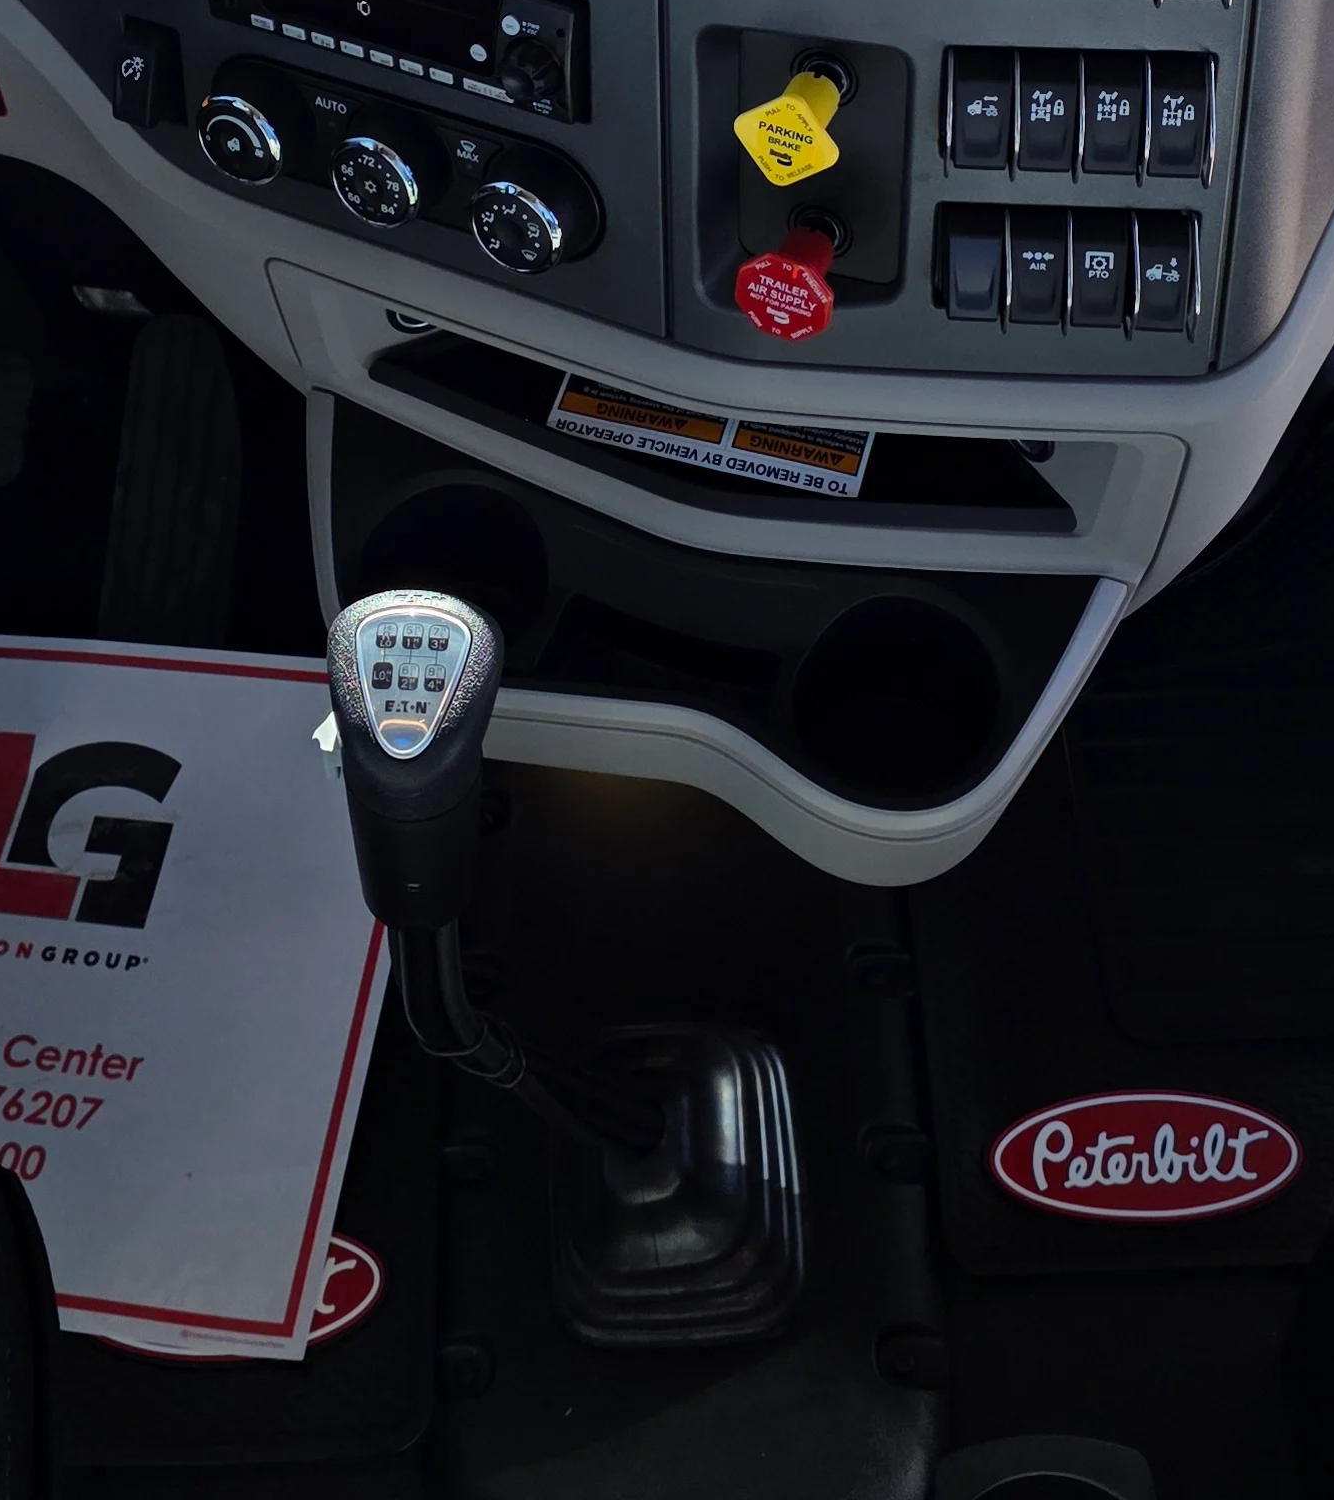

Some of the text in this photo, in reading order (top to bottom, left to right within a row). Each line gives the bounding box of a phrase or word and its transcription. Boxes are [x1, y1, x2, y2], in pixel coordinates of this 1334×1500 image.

[315, 96, 348, 115] AUTO
[786, 103, 795, 111] TO
[795, 113, 813, 132] APPLY
[759, 120, 813, 145] PARKING
[768, 136, 801, 153] BRAKE
[362, 154, 376, 168] 72
[457, 148, 480, 164] MAX
[340, 164, 354, 177] 66
[775, 173, 785, 182] TO
[786, 163, 814, 178] RELEASE
[386, 180, 400, 192] 78
[347, 192, 361, 205] 60
[380, 203, 395, 216] 84
[755, 260, 771, 270] PULL
[782, 263, 792, 271] TO
[1029, 262, 1047, 271] AIR
[1088, 270, 1109, 279] PTO
[759, 274, 809, 300] TRAILER
[747, 282, 817, 312] AIR SUPPLY
[749, 292, 812, 318] NOT FOR PARKING
[772, 327, 781, 336] TO
[629, 398, 661, 410] steering
[595, 403, 674, 430] WARNING
[751, 422, 767, 432] with
[769, 426, 806, 441] equipped
[749, 434, 829, 462] WARNING
[817, 438, 844, 450] vehicle
[845, 444, 862, 455] This
[555, 417, 849, 496] TO BE REMOVED BY VEHICLE OPERATOR
[41, 946, 145, 971] GROUP
[4, 1034, 146, 1082] Center
[1032, 1119, 1270, 1192] Peterbilt
